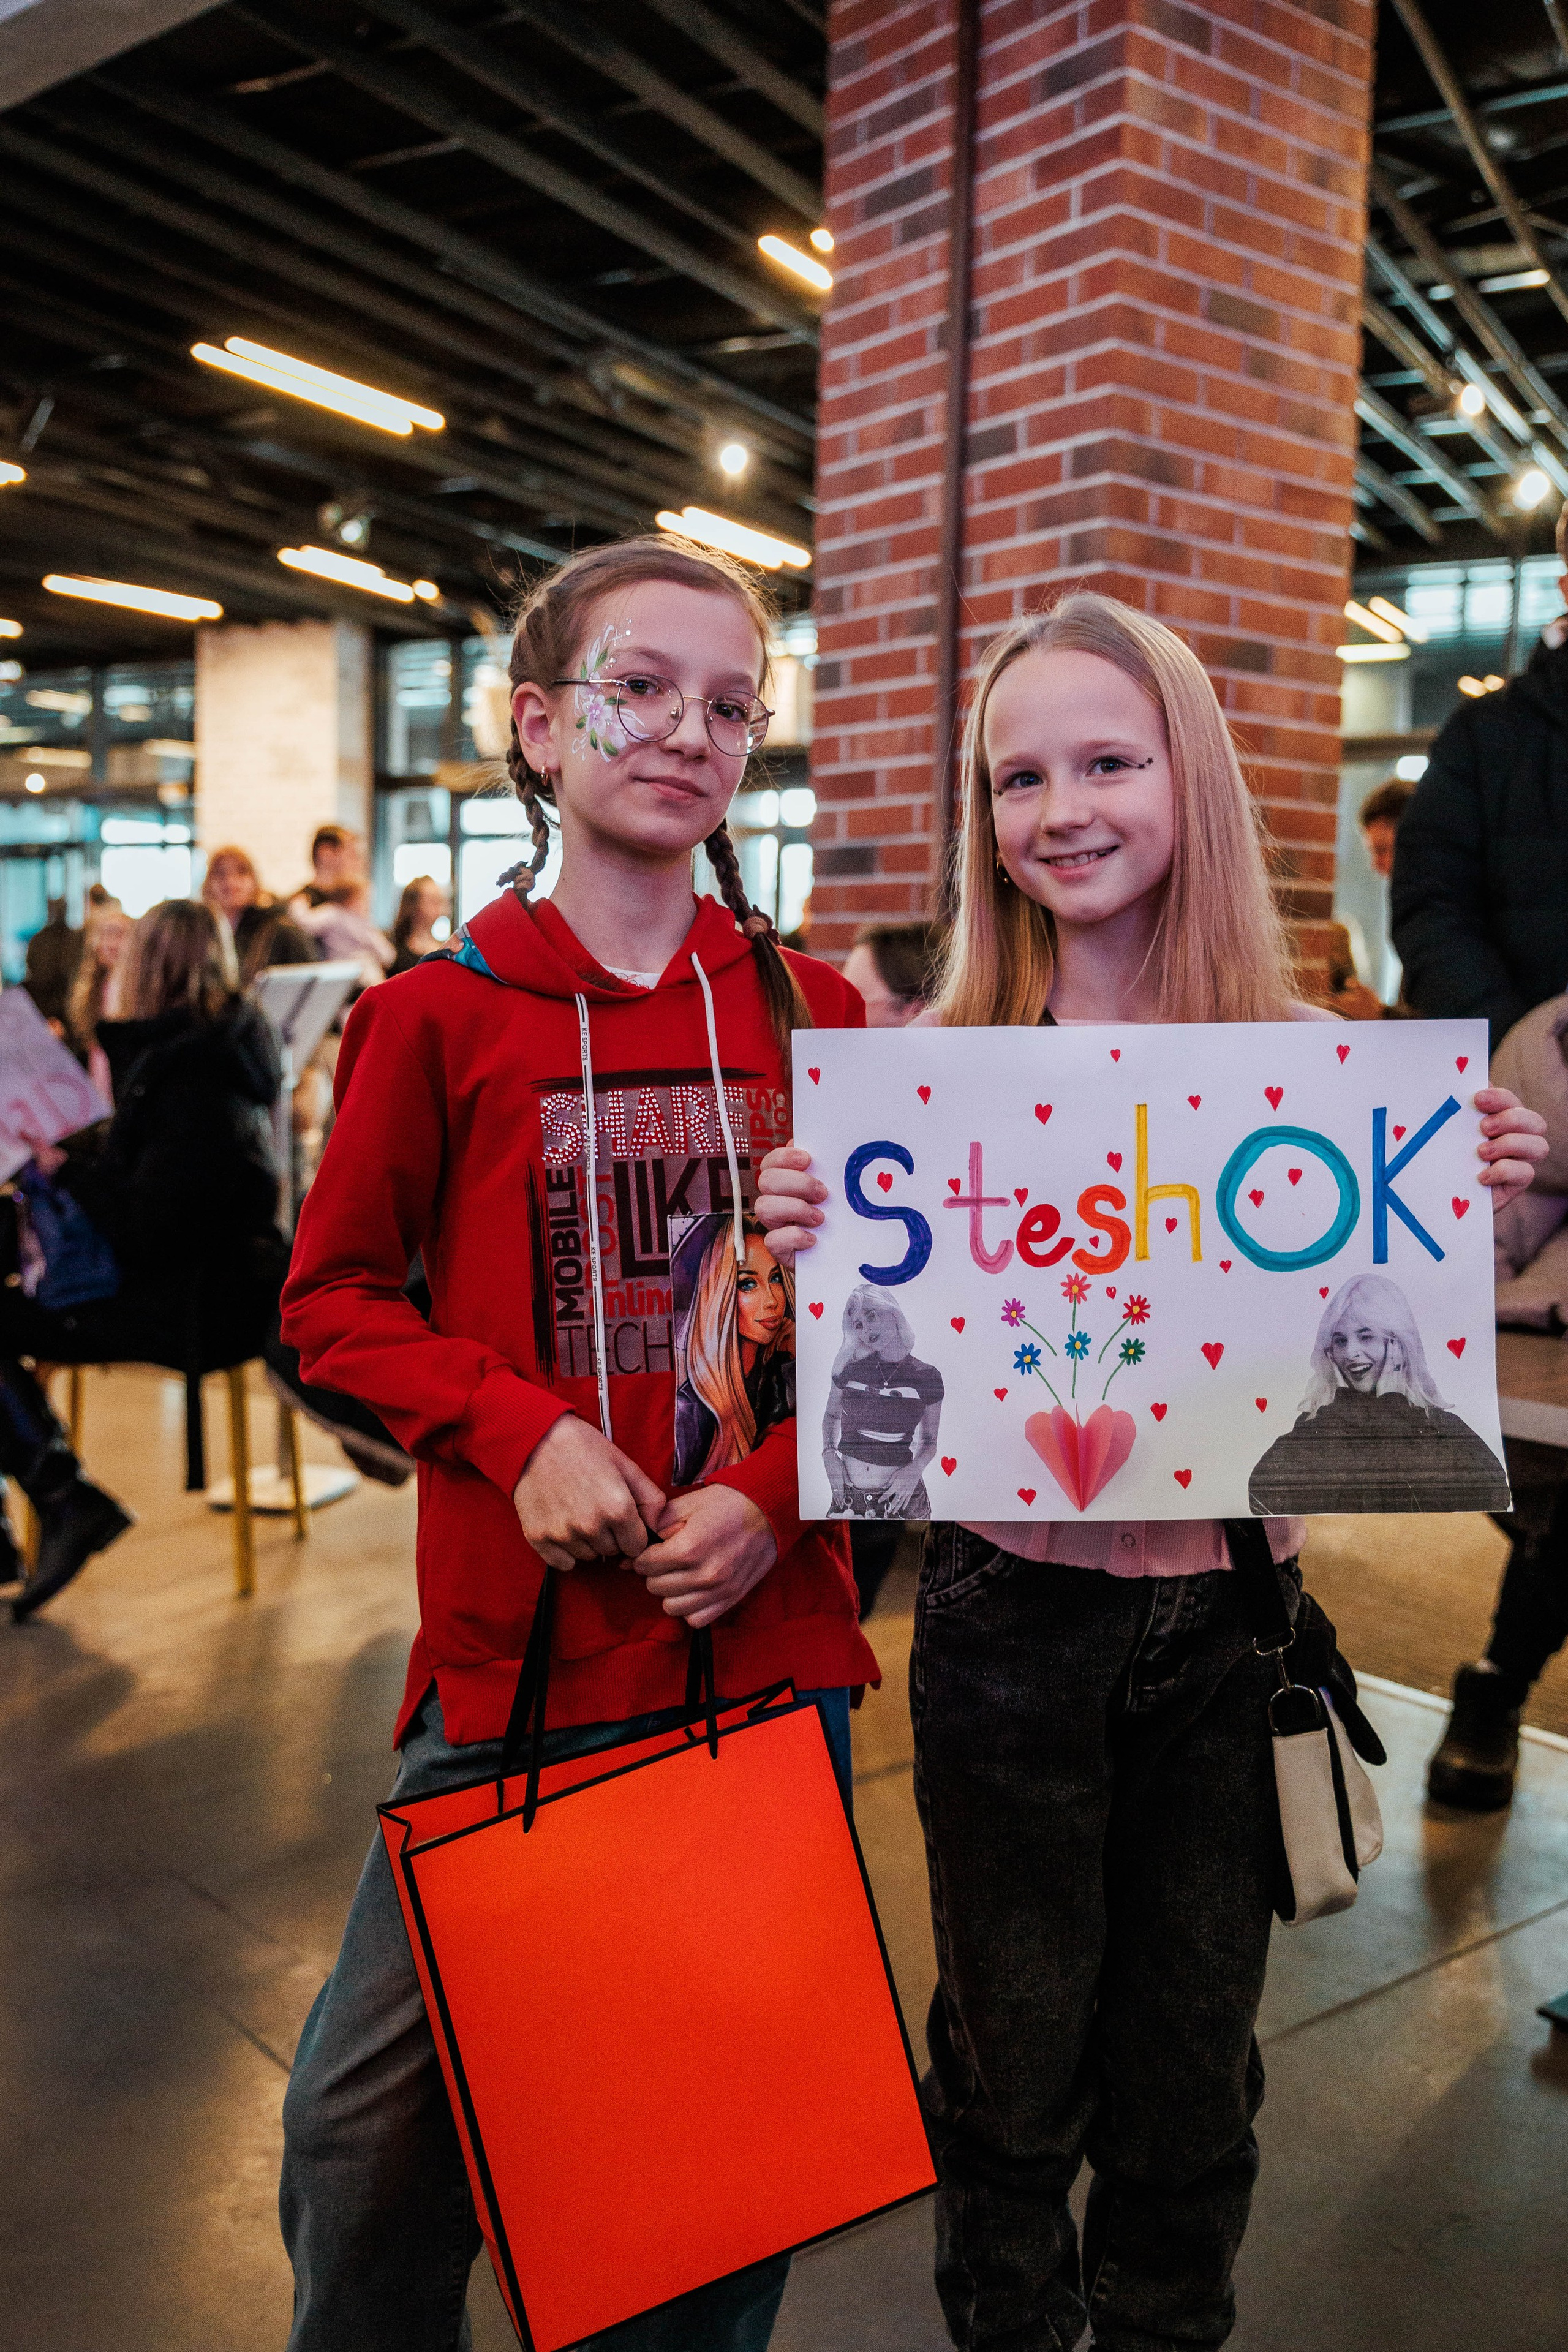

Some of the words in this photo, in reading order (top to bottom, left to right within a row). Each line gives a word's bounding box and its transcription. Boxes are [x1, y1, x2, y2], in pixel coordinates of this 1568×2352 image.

[540, 1086, 748, 1164] SHARE
[546, 1166, 584, 1322] MOBILE
[576, 1165, 619, 1290] POST
[556, 1319, 674, 1376] TECH
